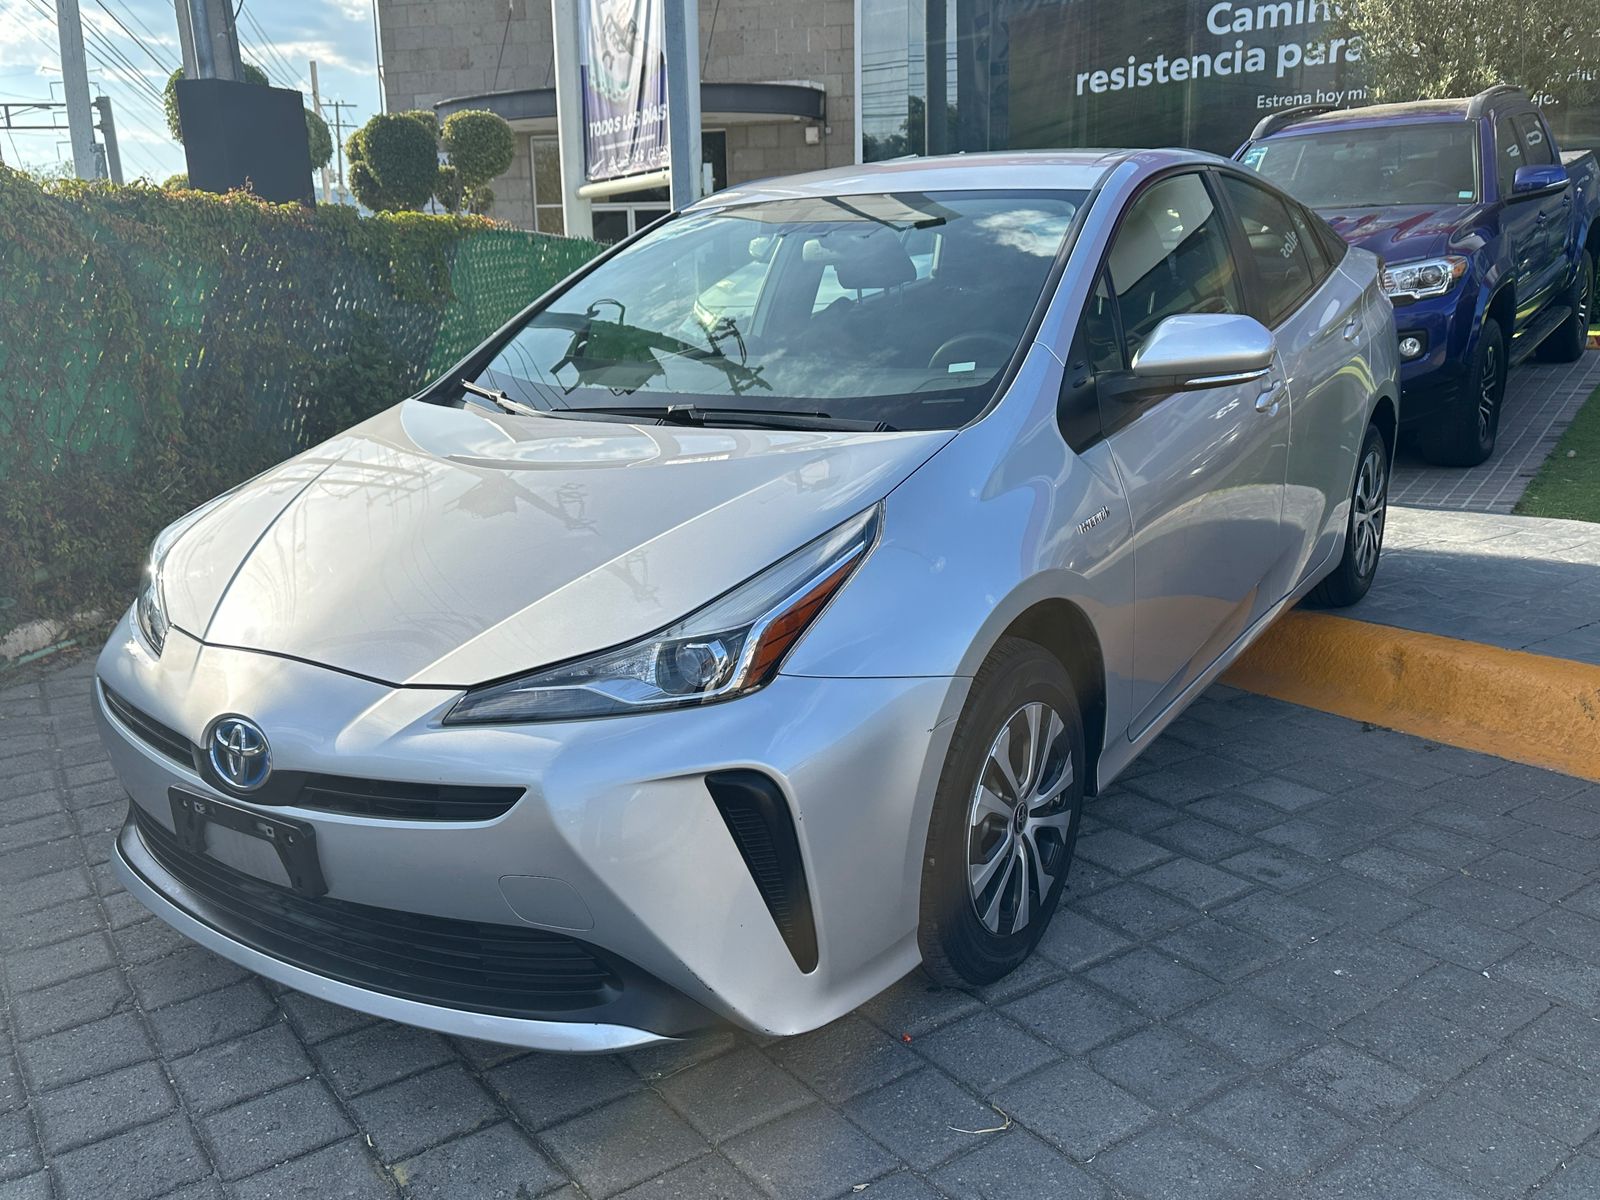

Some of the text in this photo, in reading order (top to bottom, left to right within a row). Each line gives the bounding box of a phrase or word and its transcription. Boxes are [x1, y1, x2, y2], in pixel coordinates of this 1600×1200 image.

[1076, 35, 1364, 96] resistencia para
[1256, 90, 1312, 109] Estrena
[1316, 88, 1344, 107] hoy
[589, 115, 622, 138] TODOS
[622, 111, 641, 131] LOS
